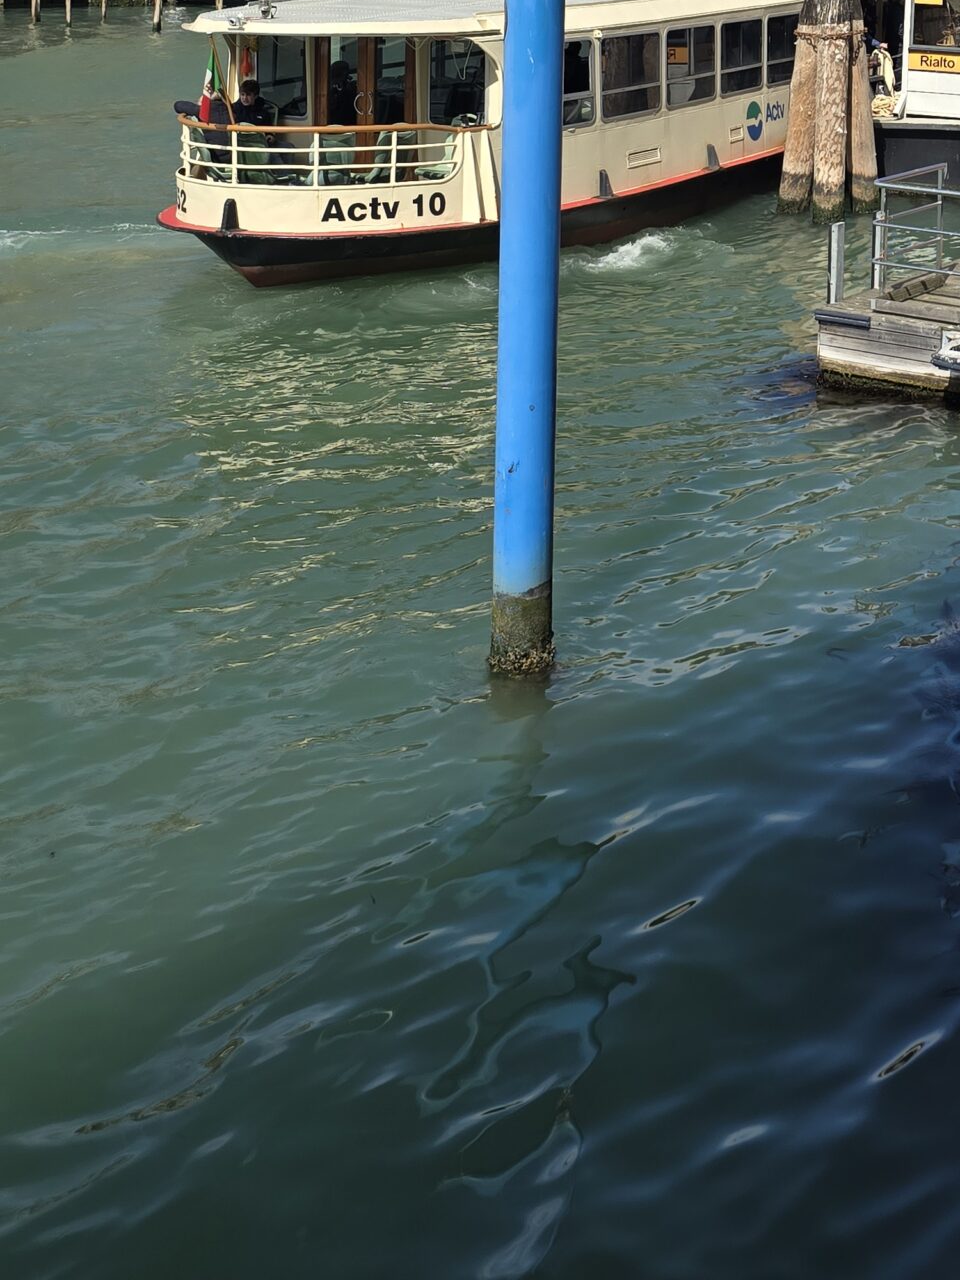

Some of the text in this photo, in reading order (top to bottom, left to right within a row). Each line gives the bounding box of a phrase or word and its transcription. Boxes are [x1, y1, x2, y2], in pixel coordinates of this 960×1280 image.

[920, 55, 955, 69] Rialto
[766, 101, 785, 123] Actv
[321, 192, 446, 222] Actv 10
